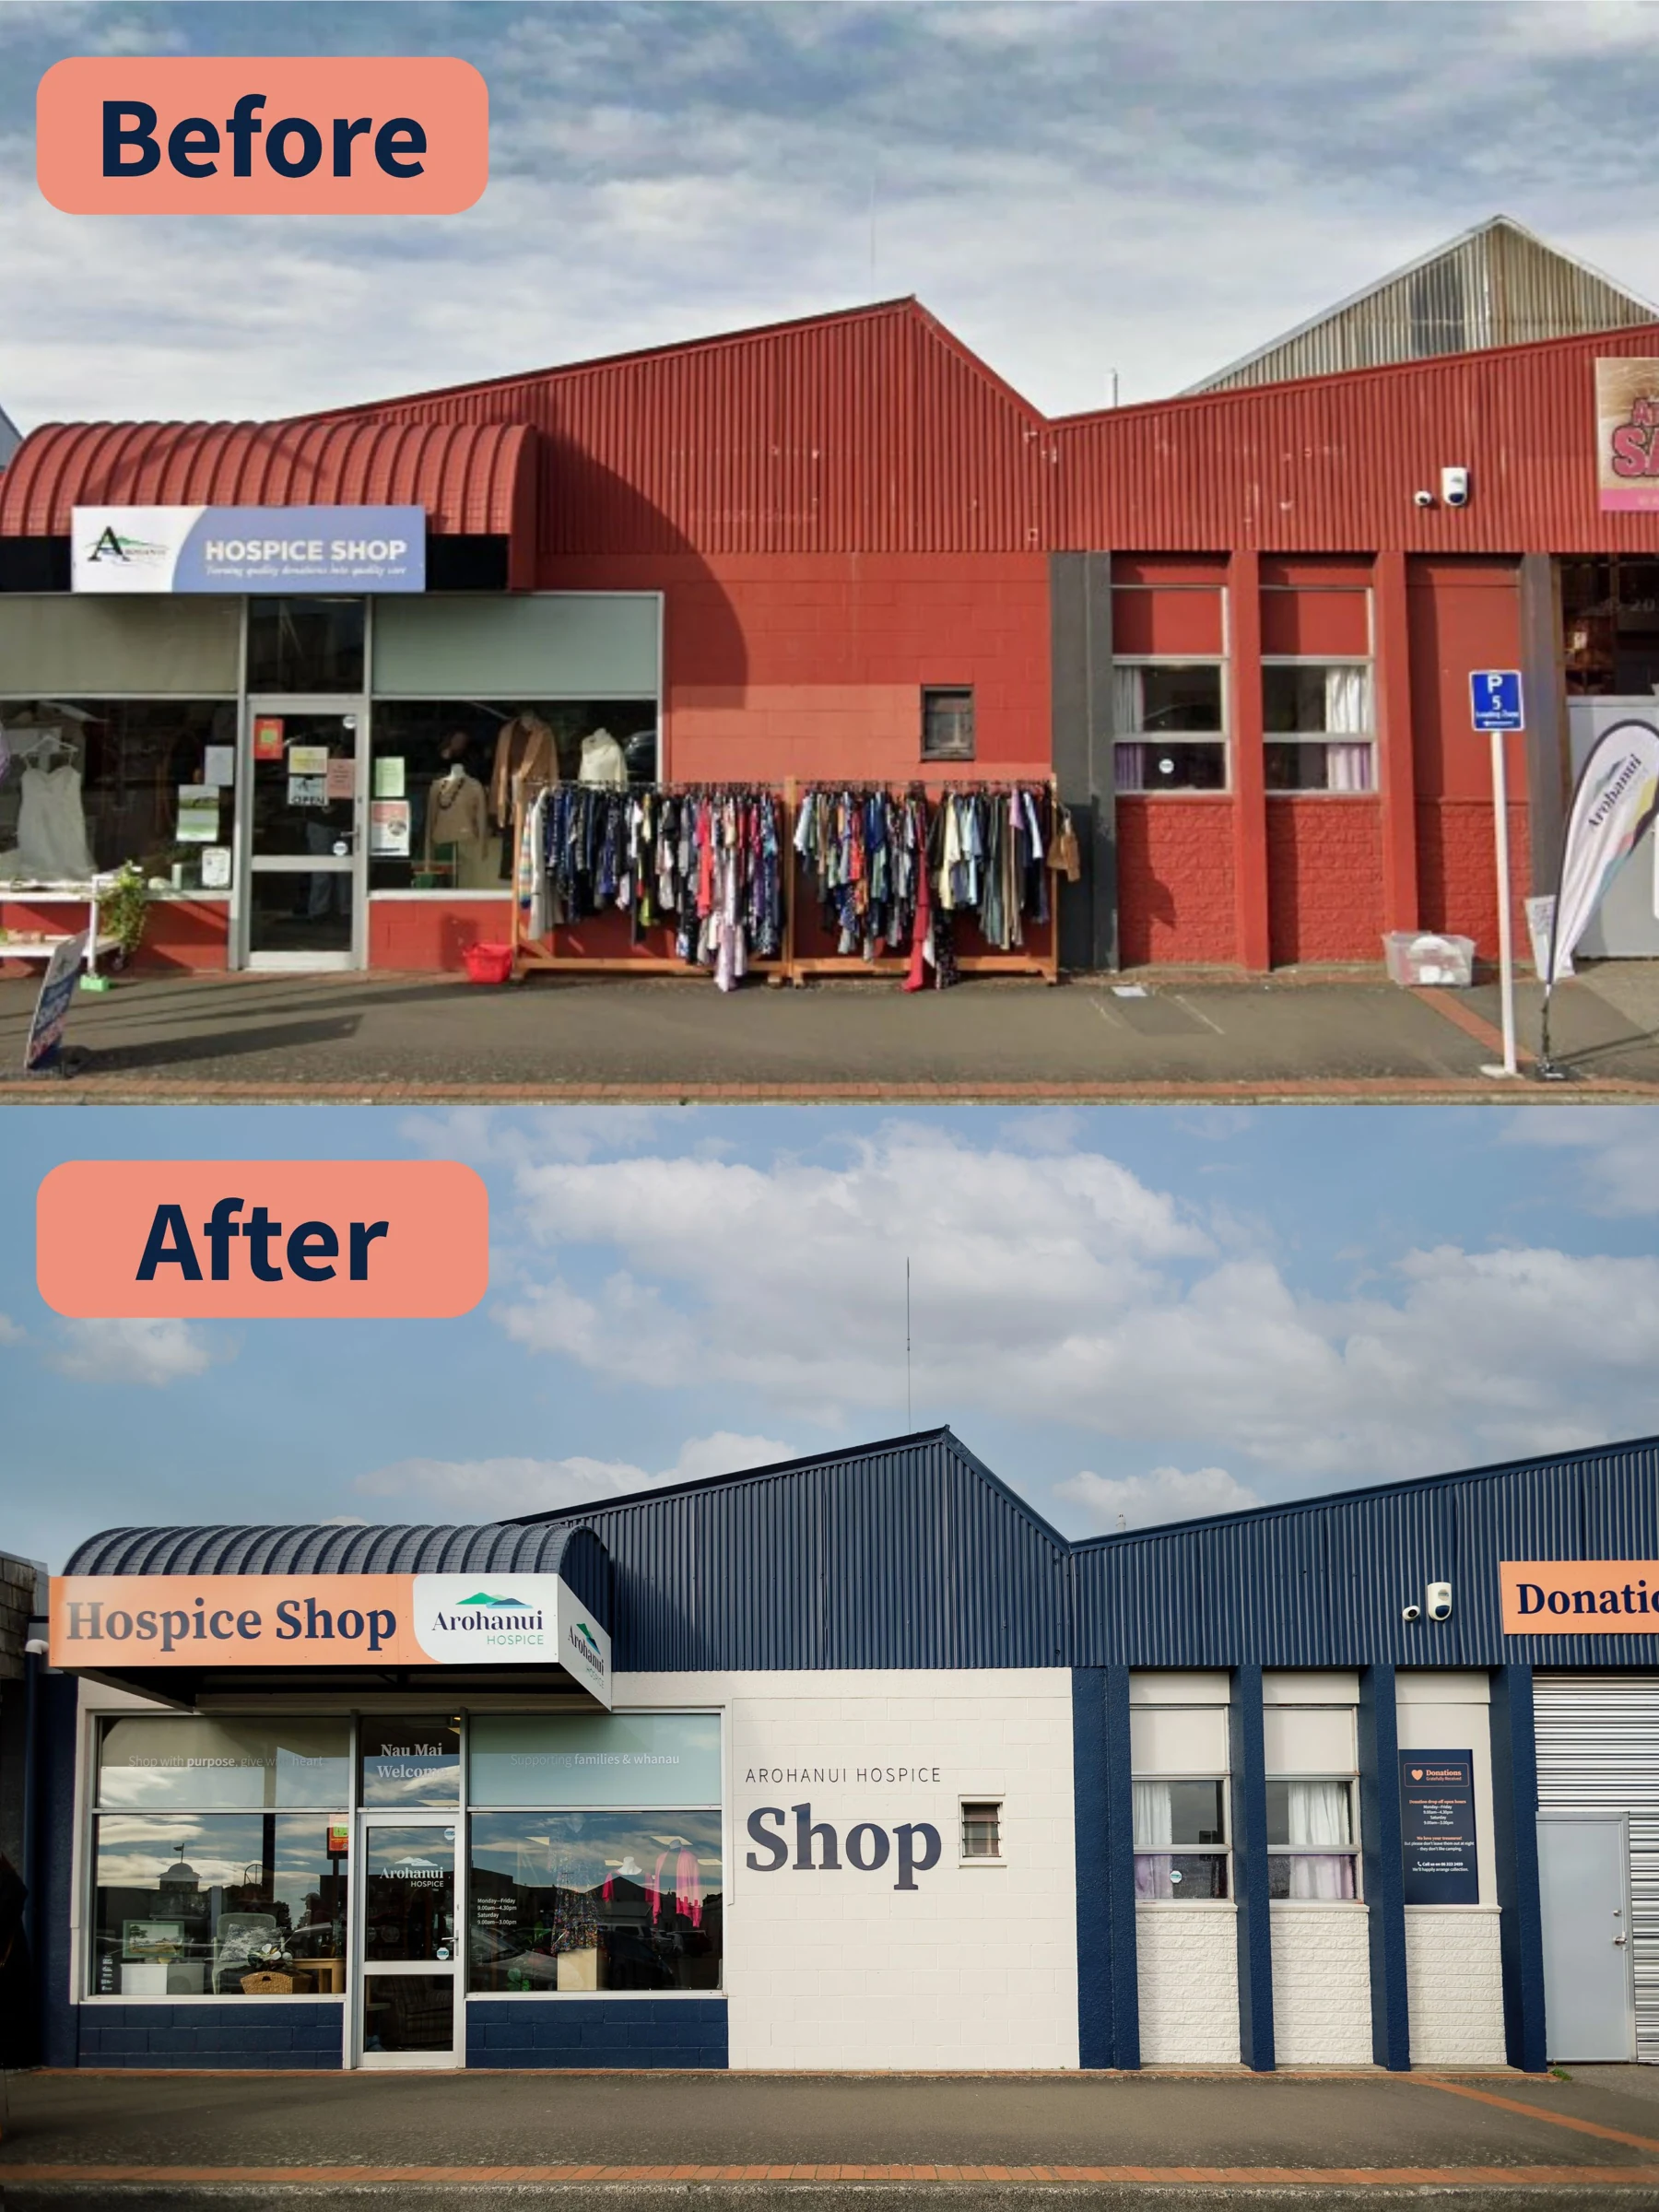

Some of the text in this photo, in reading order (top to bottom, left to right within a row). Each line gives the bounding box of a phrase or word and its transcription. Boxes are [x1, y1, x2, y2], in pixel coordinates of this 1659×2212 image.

[205, 540, 407, 561] HOSPICE SHOP
[1488, 674, 1503, 694] P
[1492, 695, 1501, 711] 5
[1588, 753, 1641, 826] Arohanui
[66, 1596, 396, 1653] Hospice Shop
[431, 1610, 544, 1630] Arohanui
[487, 1634, 544, 1645] HOSPICE
[568, 1625, 605, 1676] Arohanui
[381, 1742, 442, 1757] Nau Mai
[129, 1755, 158, 1770] Shop
[159, 1755, 183, 1767] with
[187, 1757, 238, 1770] purpose,
[241, 1756, 264, 1770] give
[292, 1754, 323, 1767] heart
[511, 1754, 572, 1768] Supporting
[574, 1753, 620, 1765] families
[622, 1754, 631, 1765] &
[746, 1767, 941, 1783] AROHANUI HOSPICE
[747, 1802, 942, 1890] Shop
[379, 1866, 444, 1879] Arohanui
